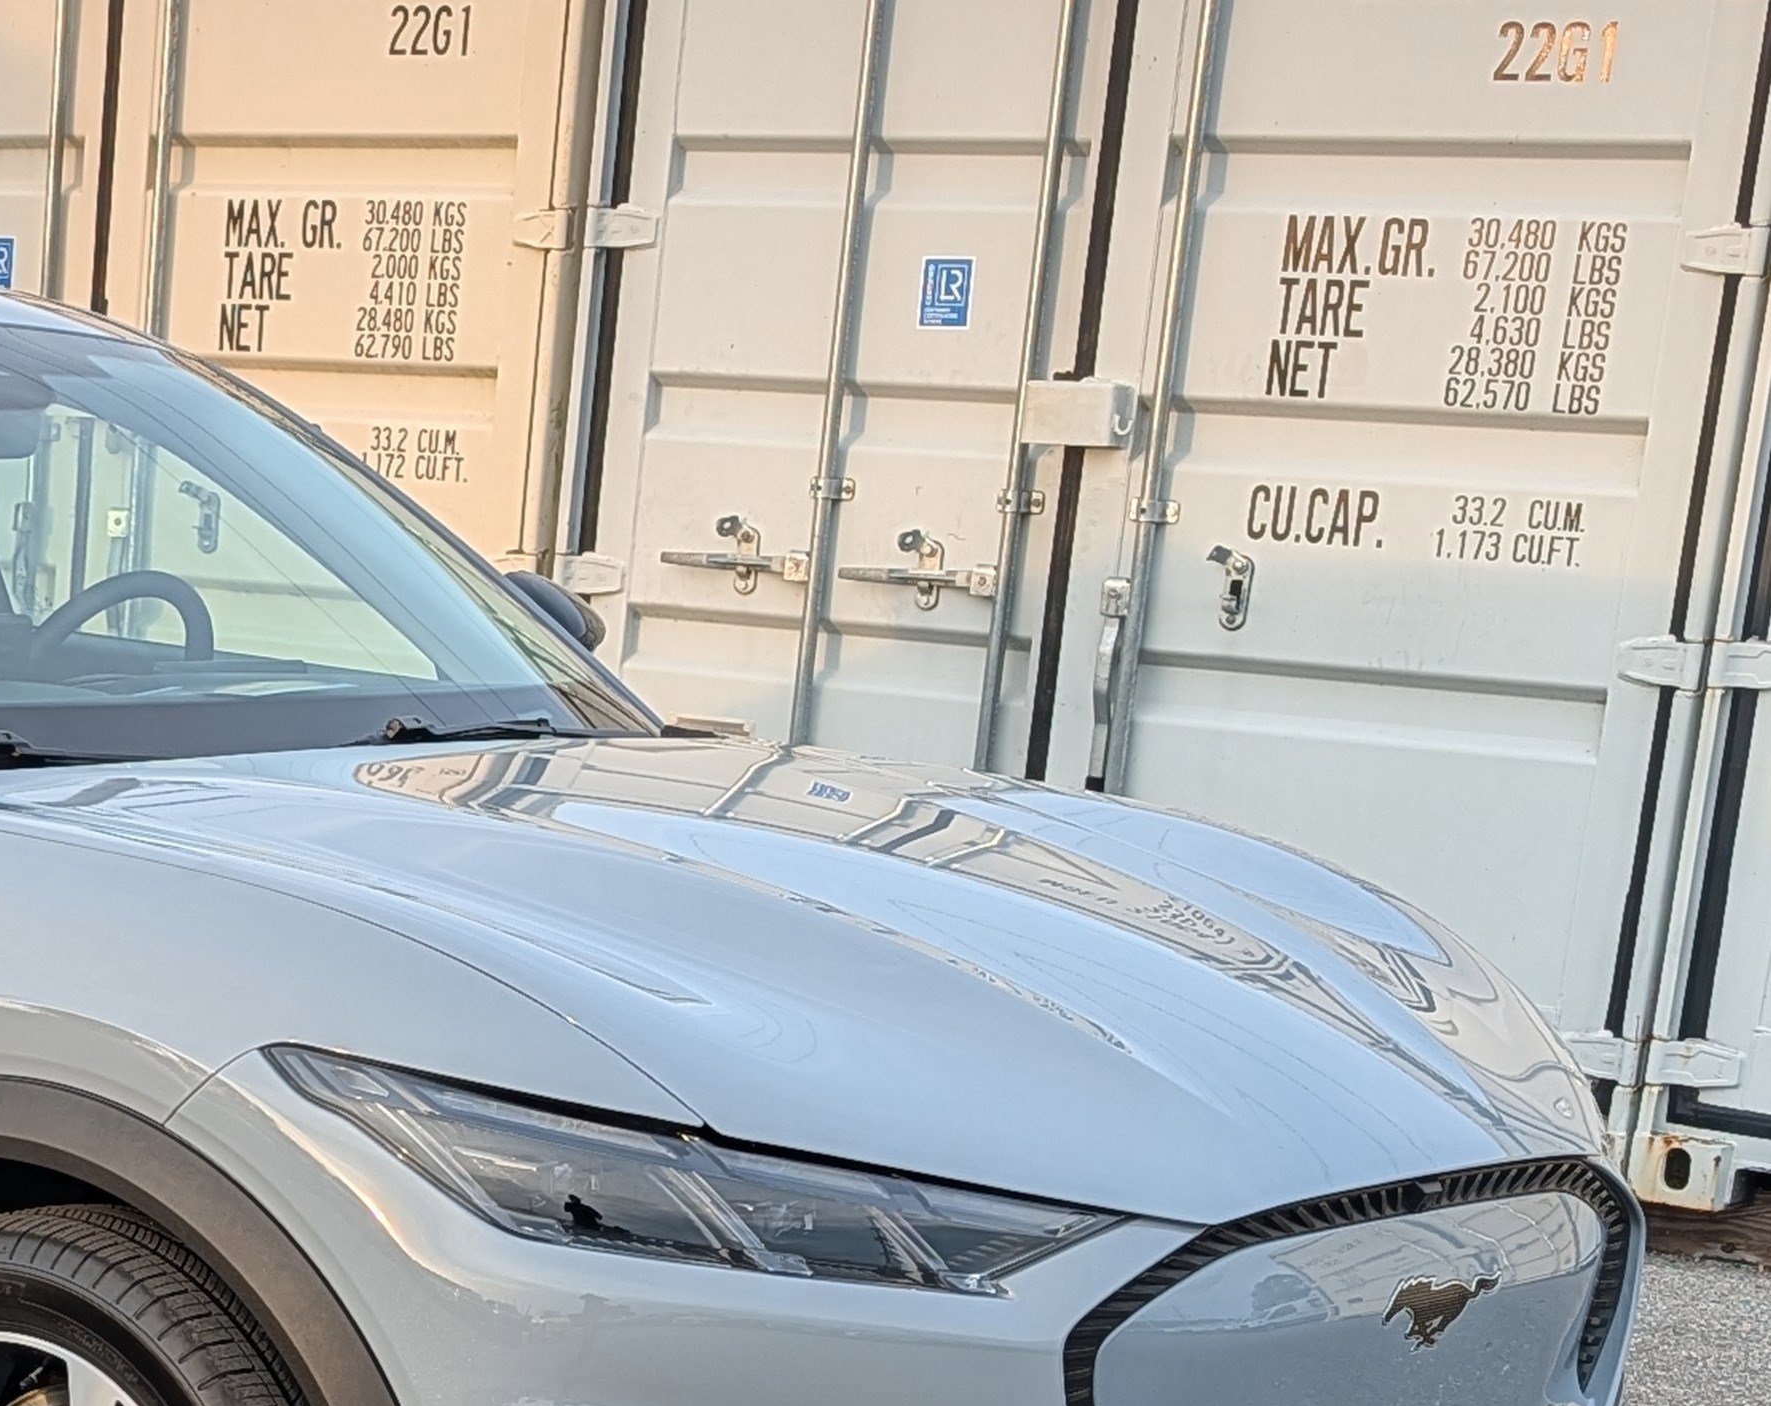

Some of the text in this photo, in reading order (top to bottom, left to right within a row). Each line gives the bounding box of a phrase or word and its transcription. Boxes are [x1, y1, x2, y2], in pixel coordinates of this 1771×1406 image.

[389, 5, 471, 56] 22G1
[1493, 21, 1619, 82] 22G1
[225, 199, 342, 249] MAX. GR.
[433, 201, 467, 227] KGS
[431, 228, 465, 254] LBS
[1578, 221, 1628, 253] KGS
[224, 251, 293, 300] TARE
[428, 256, 462, 280] KGS
[1573, 254, 1622, 286] LBS
[426, 282, 460, 308] LBS
[1280, 277, 1370, 337] TARE
[1567, 286, 1617, 318] KGS
[218, 303, 270, 352] NET
[424, 309, 457, 335] KGS
[1562, 318, 1611, 350] LBS
[422, 336, 455, 361] LBS
[1265, 339, 1338, 398] NET
[1557, 351, 1606, 382] KGS
[1552, 383, 1601, 415] LBS
[370, 426, 460, 455] 33.2 CU.M.
[361, 452, 468, 483] 172 CU.FT.
[1246, 484, 1382, 548] CU.CAP.
[1452, 495, 1585, 532] 33.2 CU.M.
[1512, 533, 1580, 567] CU.FT.
